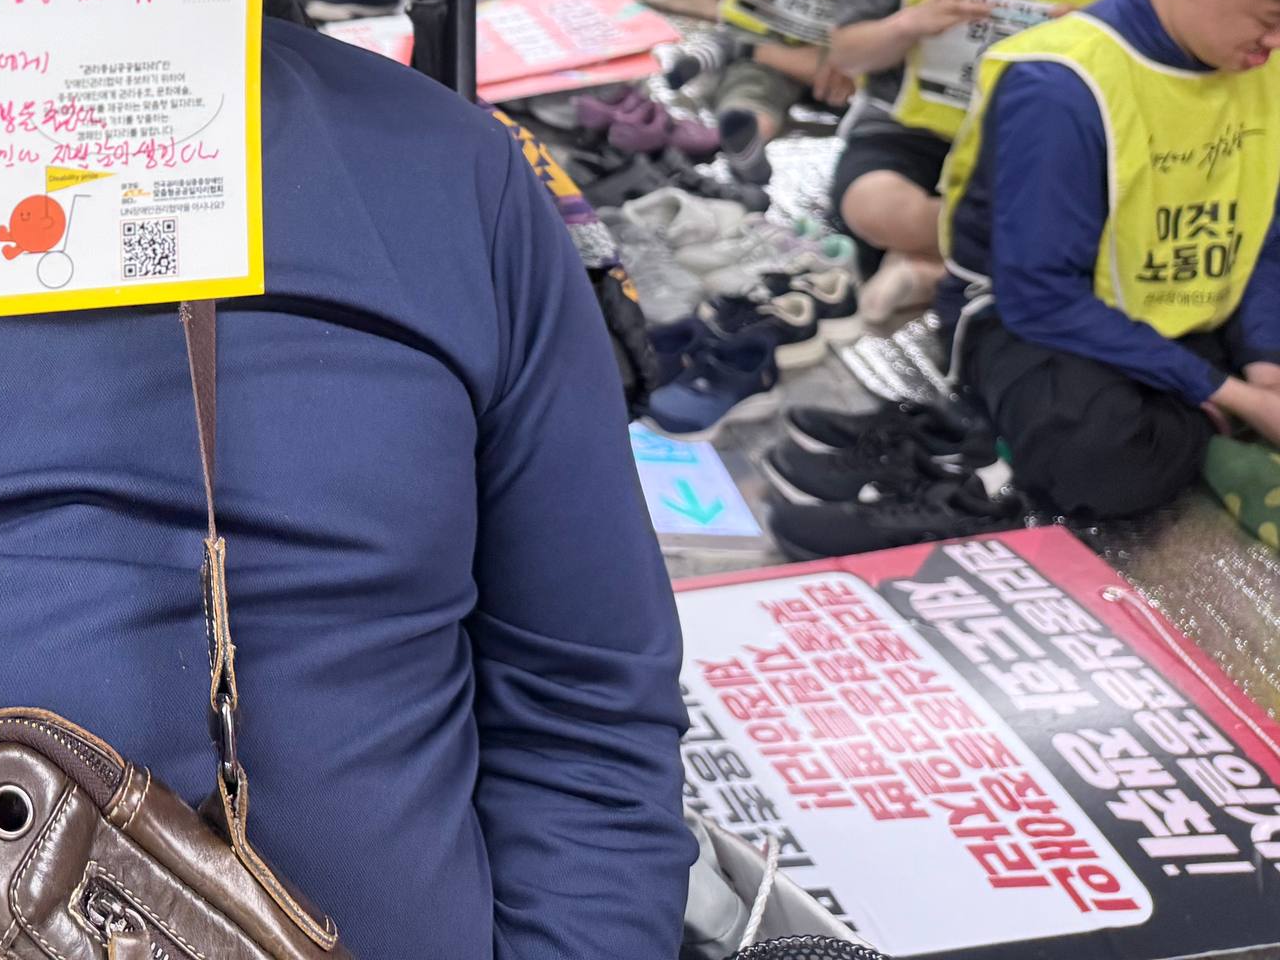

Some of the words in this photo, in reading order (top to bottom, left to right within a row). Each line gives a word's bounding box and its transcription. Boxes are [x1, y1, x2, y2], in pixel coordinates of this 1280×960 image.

[693, 656, 858, 811] 제정하라!
[744, 644, 931, 822] 지원특별법
[893, 576, 1100, 715] 제도화
[1051, 726, 1257, 877] 쟁취!
